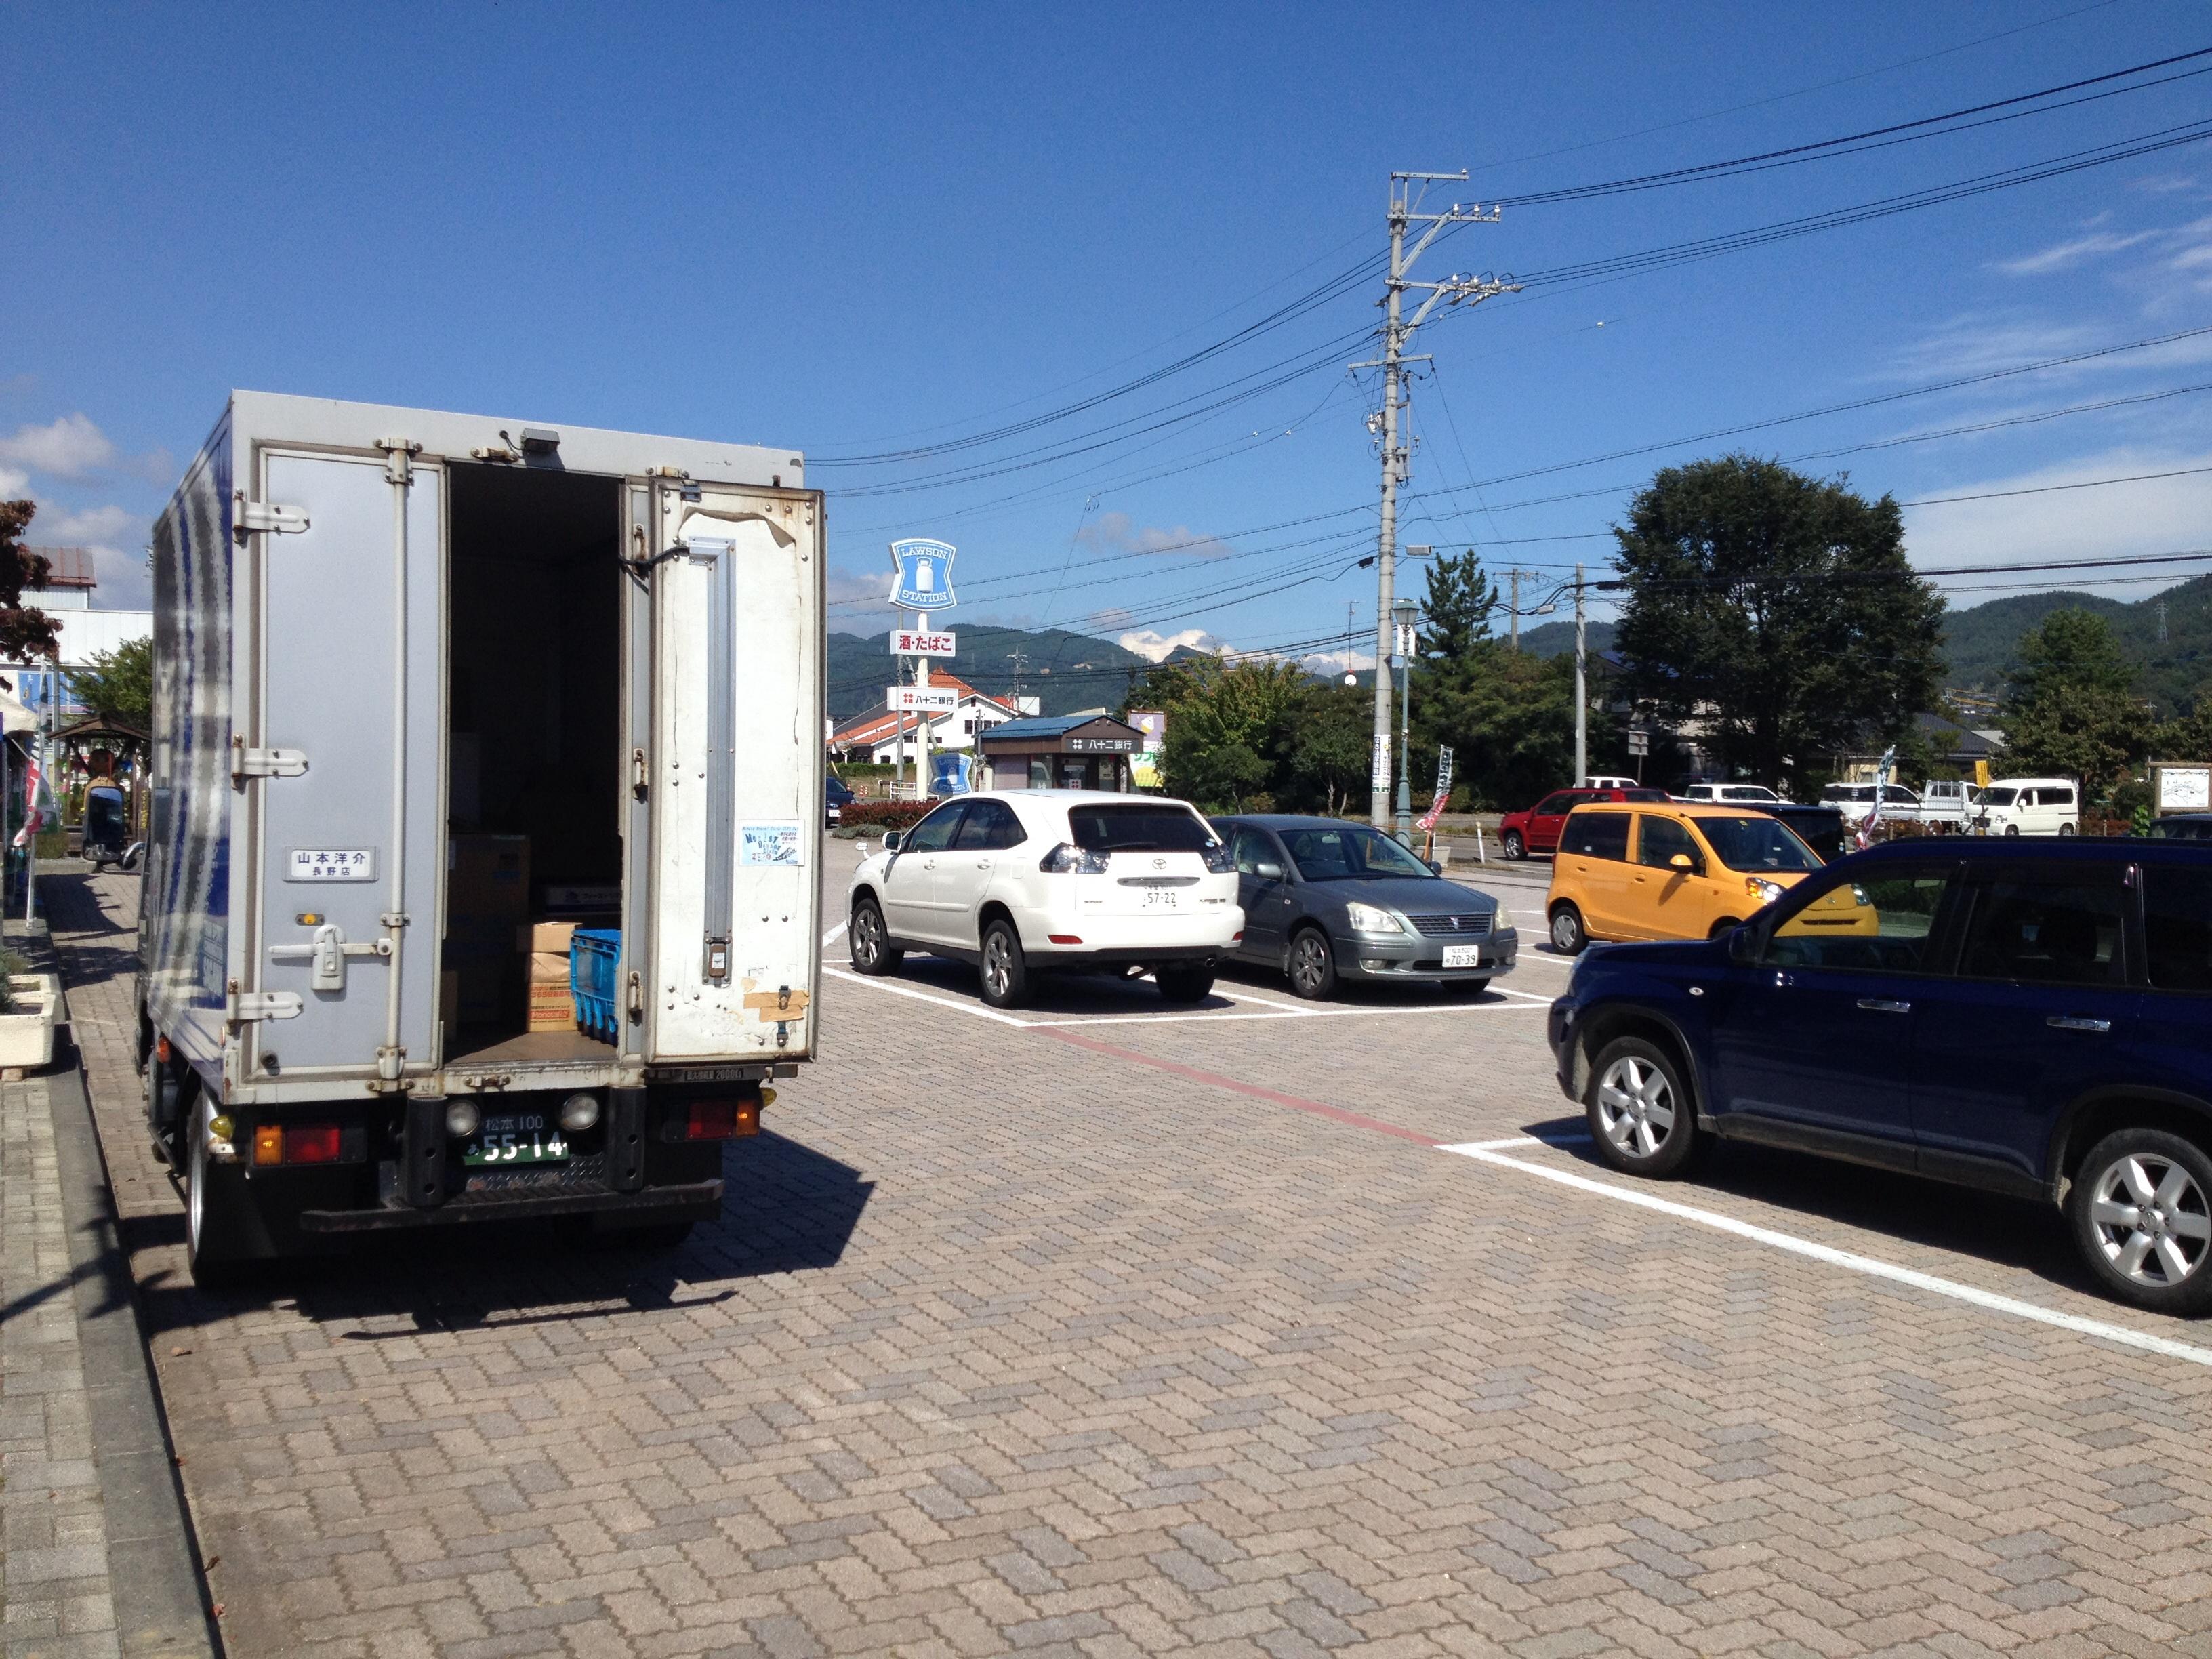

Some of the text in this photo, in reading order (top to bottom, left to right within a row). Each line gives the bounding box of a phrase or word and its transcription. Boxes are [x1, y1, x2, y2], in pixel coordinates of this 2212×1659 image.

[900, 546, 948, 560] LAWSON
[901, 589, 948, 602] STATION
[899, 634, 952, 651] 酒・たばこ
[915, 695, 954, 705] 八十二銀行
[1088, 739, 1132, 750] 八十二銀行
[298, 852, 365, 865] 山本洋介
[312, 867, 351, 876] 長野店
[1147, 893, 1176, 904] 57-22
[1450, 954, 1476, 966] 70-39
[485, 1115, 543, 1131] 松本 100
[483, 1131, 563, 1161] 55-14
